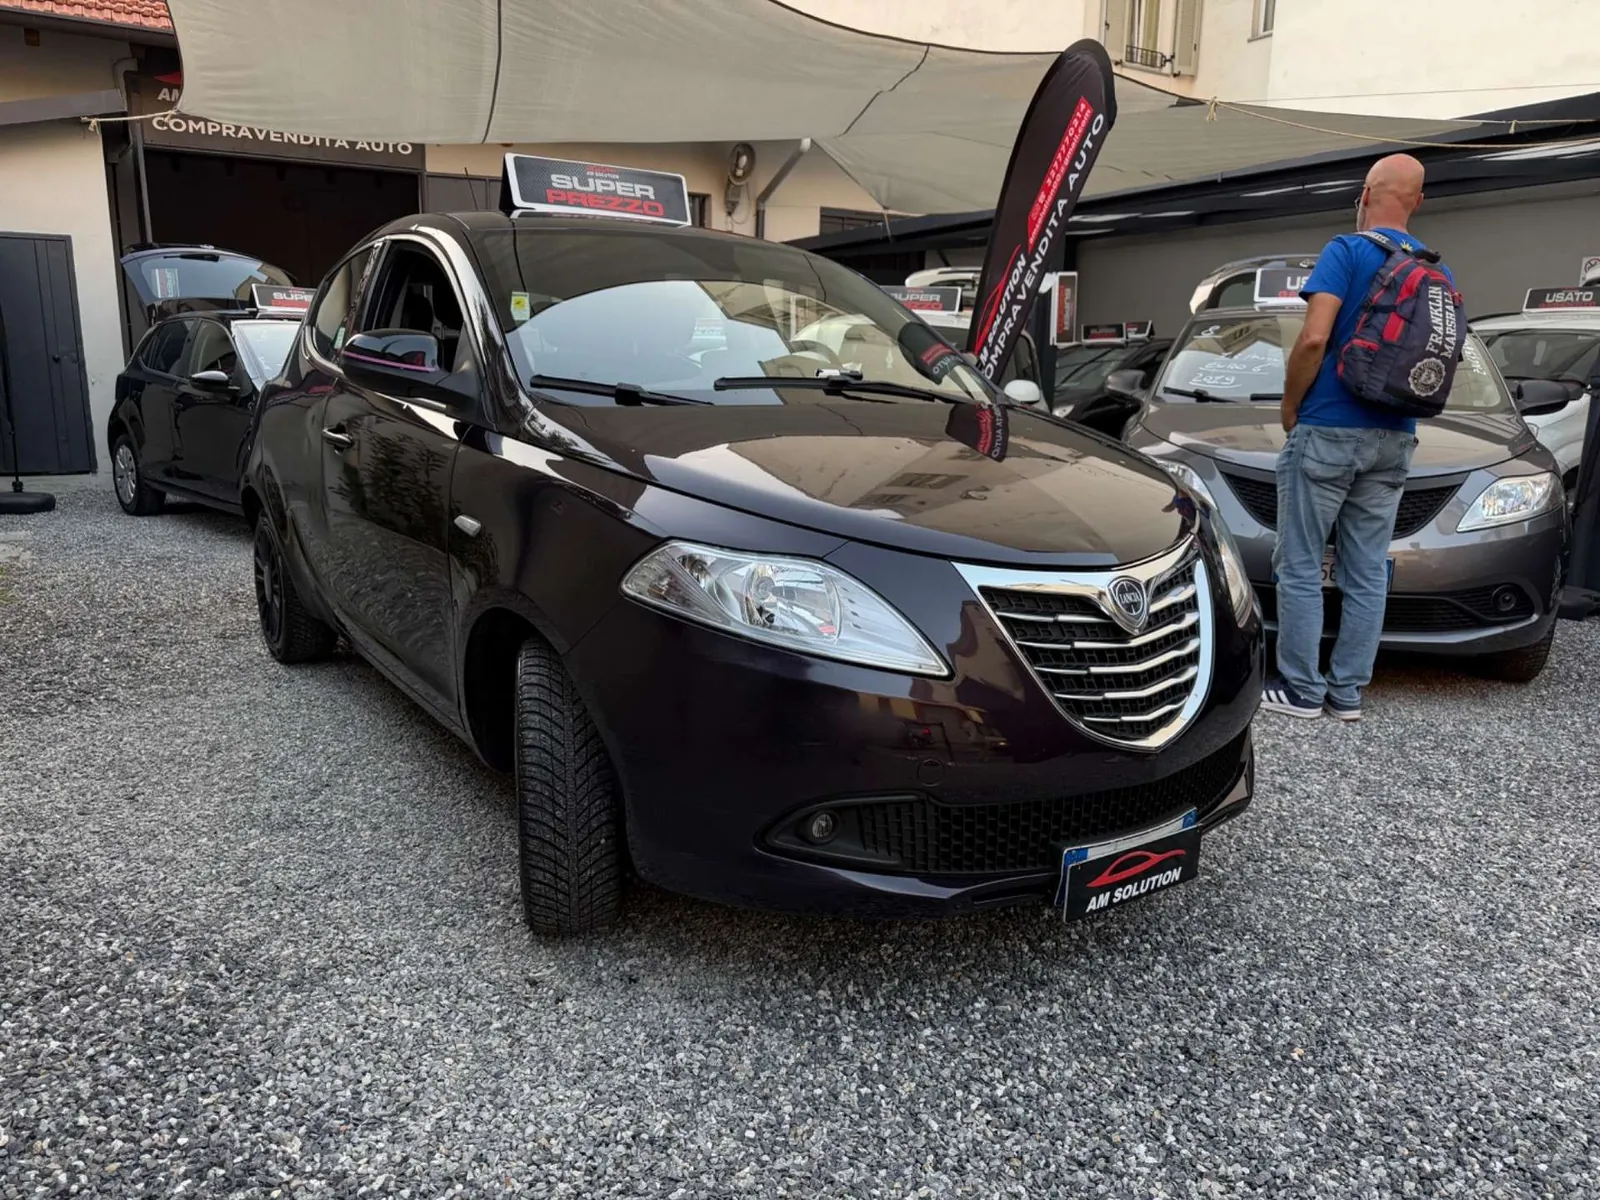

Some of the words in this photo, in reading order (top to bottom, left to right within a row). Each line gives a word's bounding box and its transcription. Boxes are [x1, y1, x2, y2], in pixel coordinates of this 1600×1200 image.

[152, 116, 350, 148] COMPRAVENDITA
[355, 140, 412, 155] AUTO
[546, 188, 664, 217] PREZZO
[550, 174, 655, 200] SUPER
[983, 199, 1068, 379] OMPRAVENDITA
[1068, 113, 1104, 191] AUTO
[988, 253, 1026, 346] SOLUTION
[1545, 291, 1594, 303] USATO
[1425, 286, 1443, 353] FRANKLIN
[1085, 891, 1111, 913] AM
[1112, 866, 1182, 904] SOLUTION
